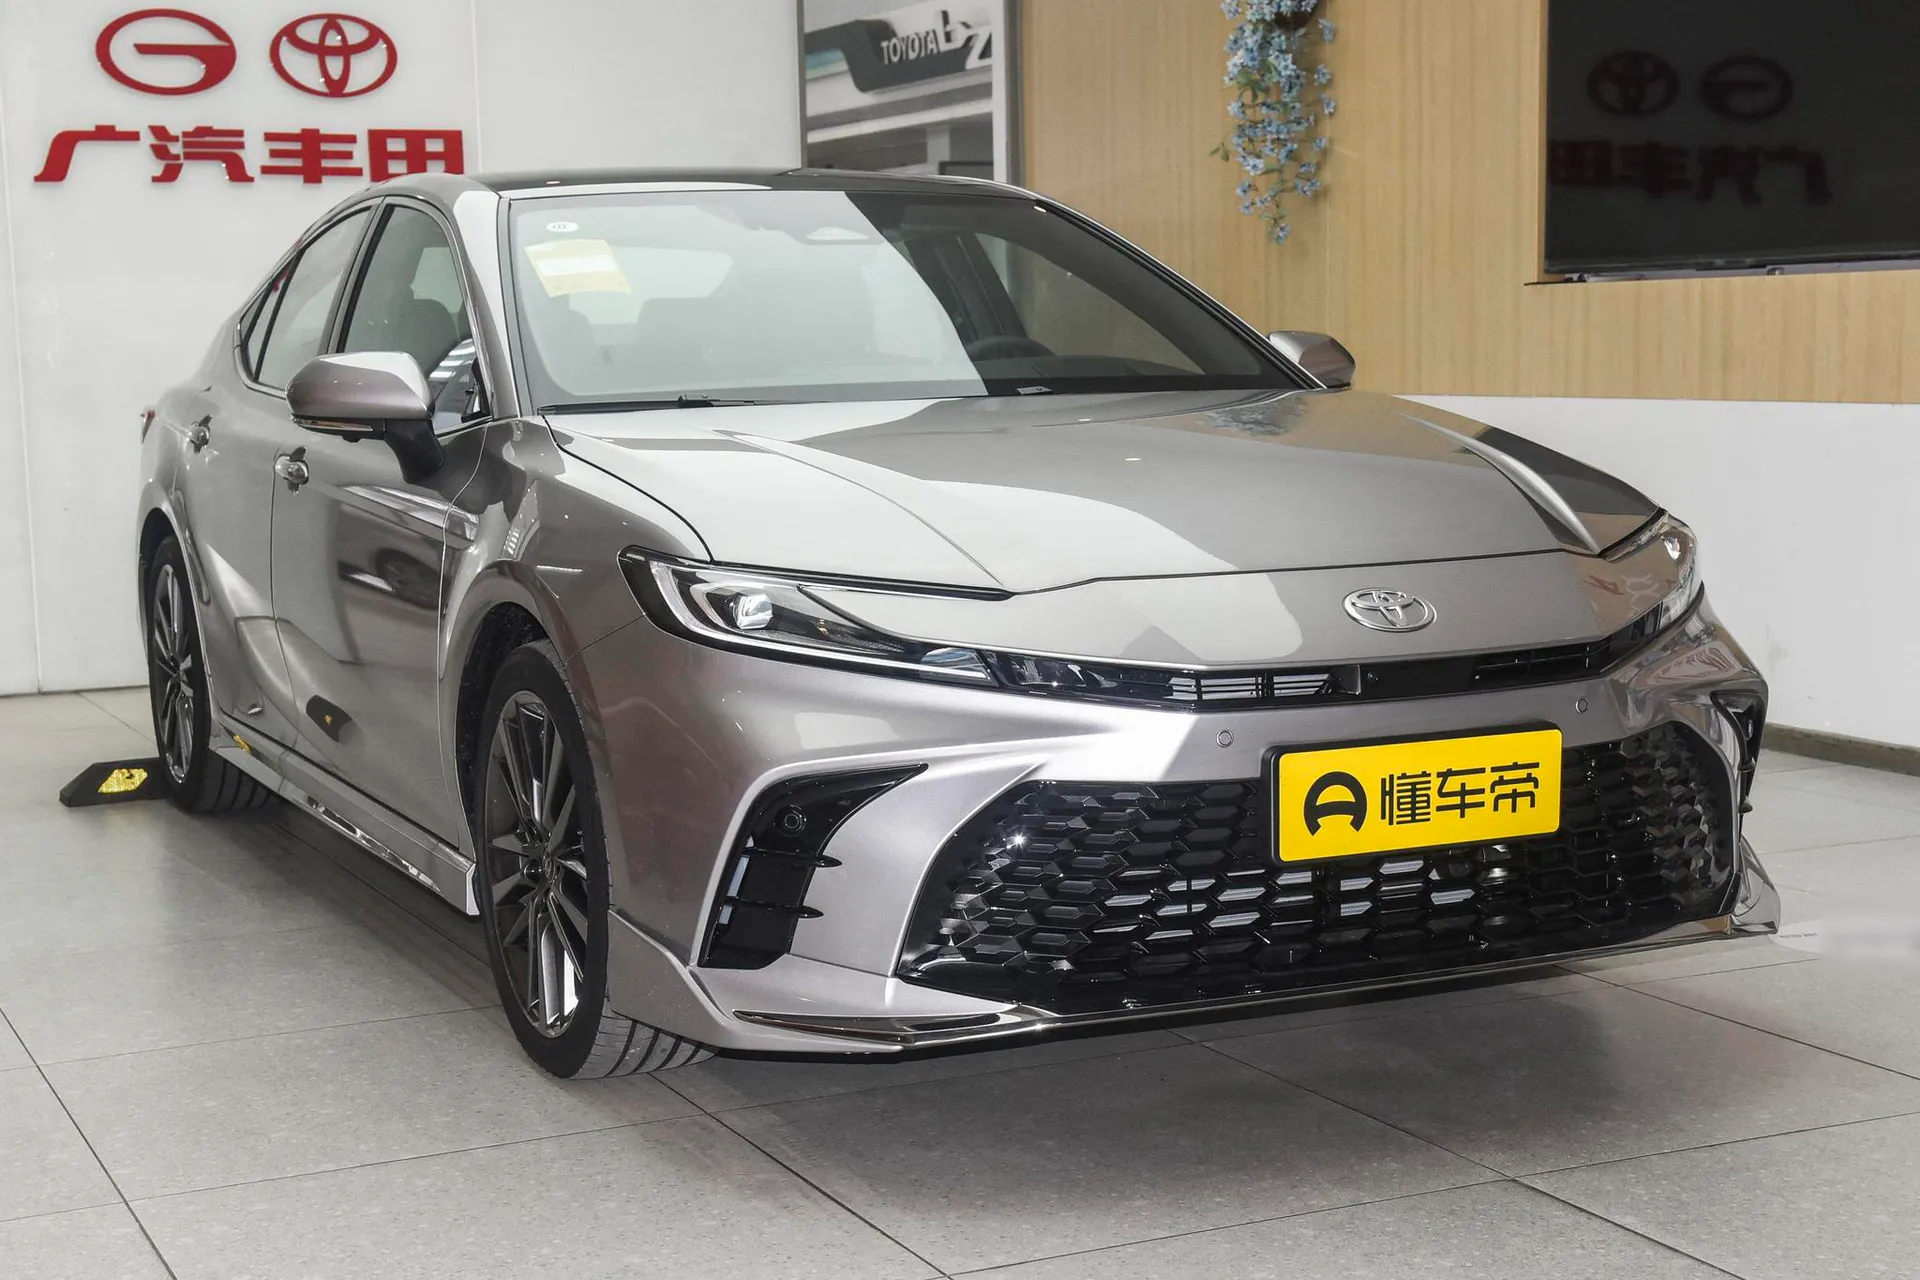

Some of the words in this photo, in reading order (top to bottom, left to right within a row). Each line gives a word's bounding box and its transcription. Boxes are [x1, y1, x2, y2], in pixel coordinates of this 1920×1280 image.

[881, 28, 940, 65] TOYOTA
[34, 125, 464, 183] 广汽丰田
[1381, 762, 1540, 825] 懂车帝
